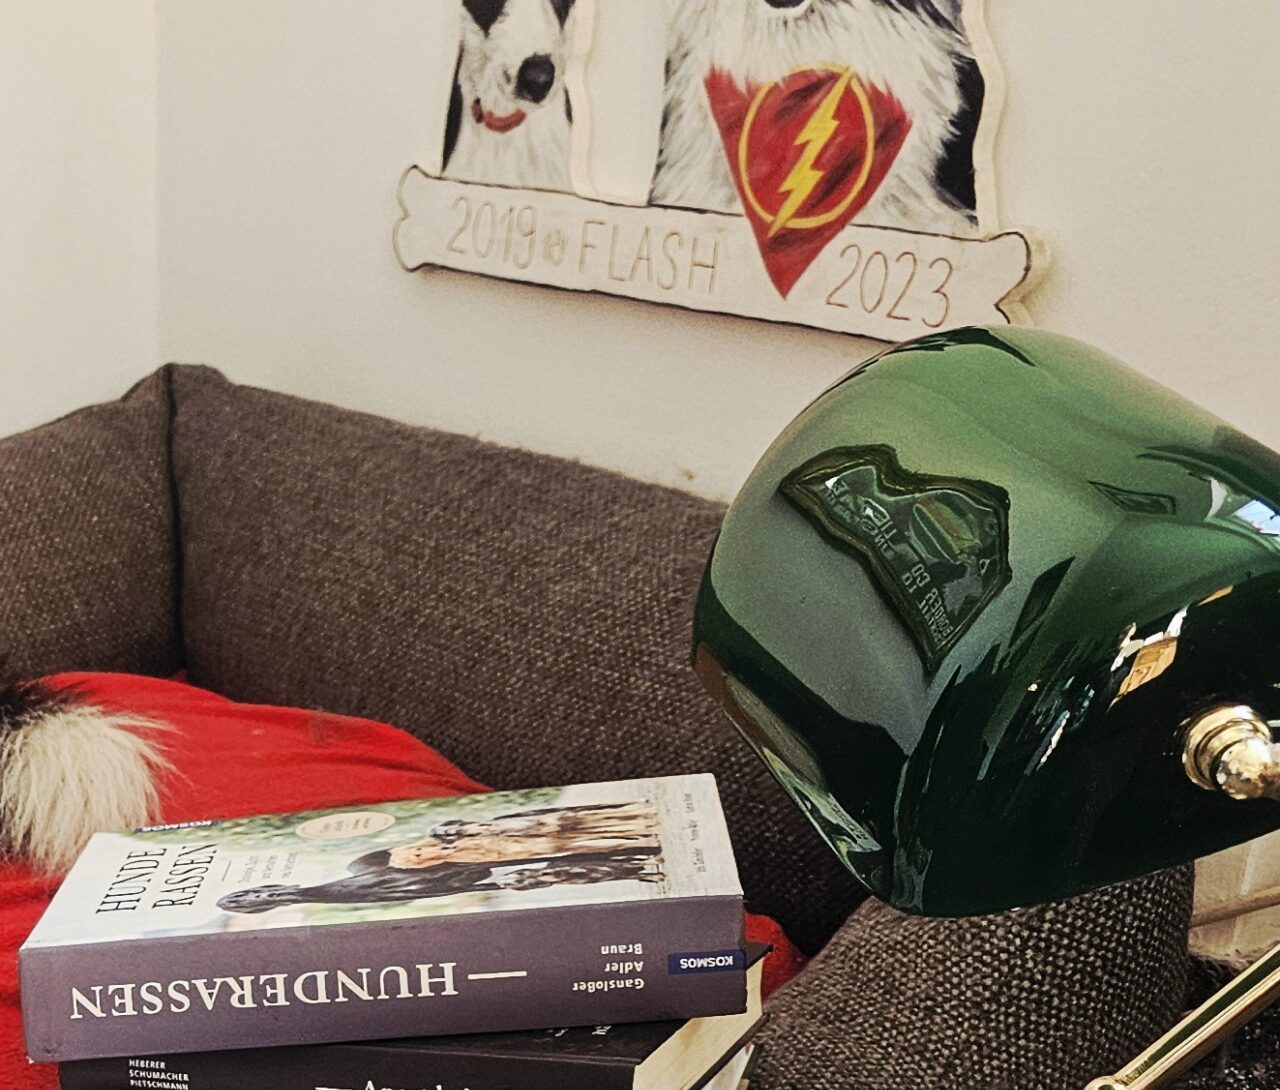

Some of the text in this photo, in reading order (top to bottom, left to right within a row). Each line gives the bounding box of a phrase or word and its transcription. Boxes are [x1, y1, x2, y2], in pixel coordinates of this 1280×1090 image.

[446, 195, 955, 329] 2019 FLASH 2023
[96, 848, 167, 914] HUNDE
[152, 844, 217, 909] RASSEN
[601, 943, 643, 955] Braun
[604, 961, 644, 974] Adler
[679, 956, 733, 969] KOSMOS
[70, 962, 459, 1020] HUNDERASSEN
[572, 978, 645, 993] Gansloßer
[129, 1070, 190, 1081] SCHUMACHER
[130, 1080, 189, 1090] PIETSCHMANN
